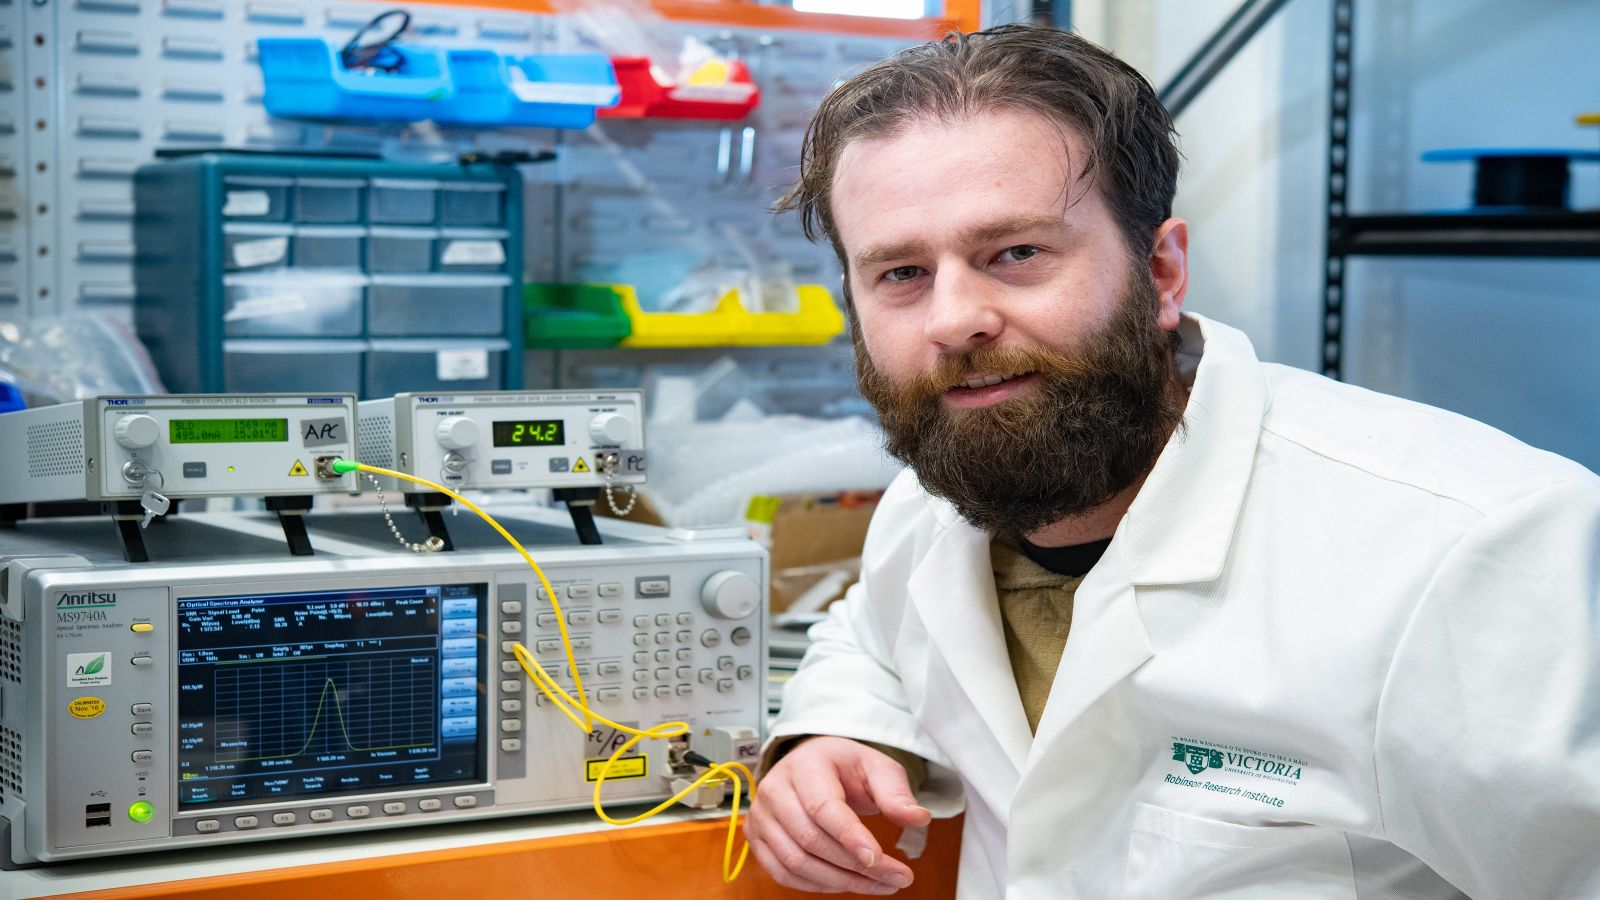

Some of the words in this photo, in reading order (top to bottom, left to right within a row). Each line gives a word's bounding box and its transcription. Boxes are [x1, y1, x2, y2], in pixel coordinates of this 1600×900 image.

[175, 421, 195, 431] SLD
[305, 423, 339, 440] APC
[512, 424, 557, 442] 24.2
[57, 592, 116, 606] Anritsu
[56, 611, 107, 623] MS9740A
[1224, 766, 1254, 777] UNIVERSITY
[1227, 752, 1301, 780] VICTORIA
[1164, 773, 1202, 788] Robinson
[1202, 781, 1241, 796] Research
[1241, 789, 1285, 808] Institute
